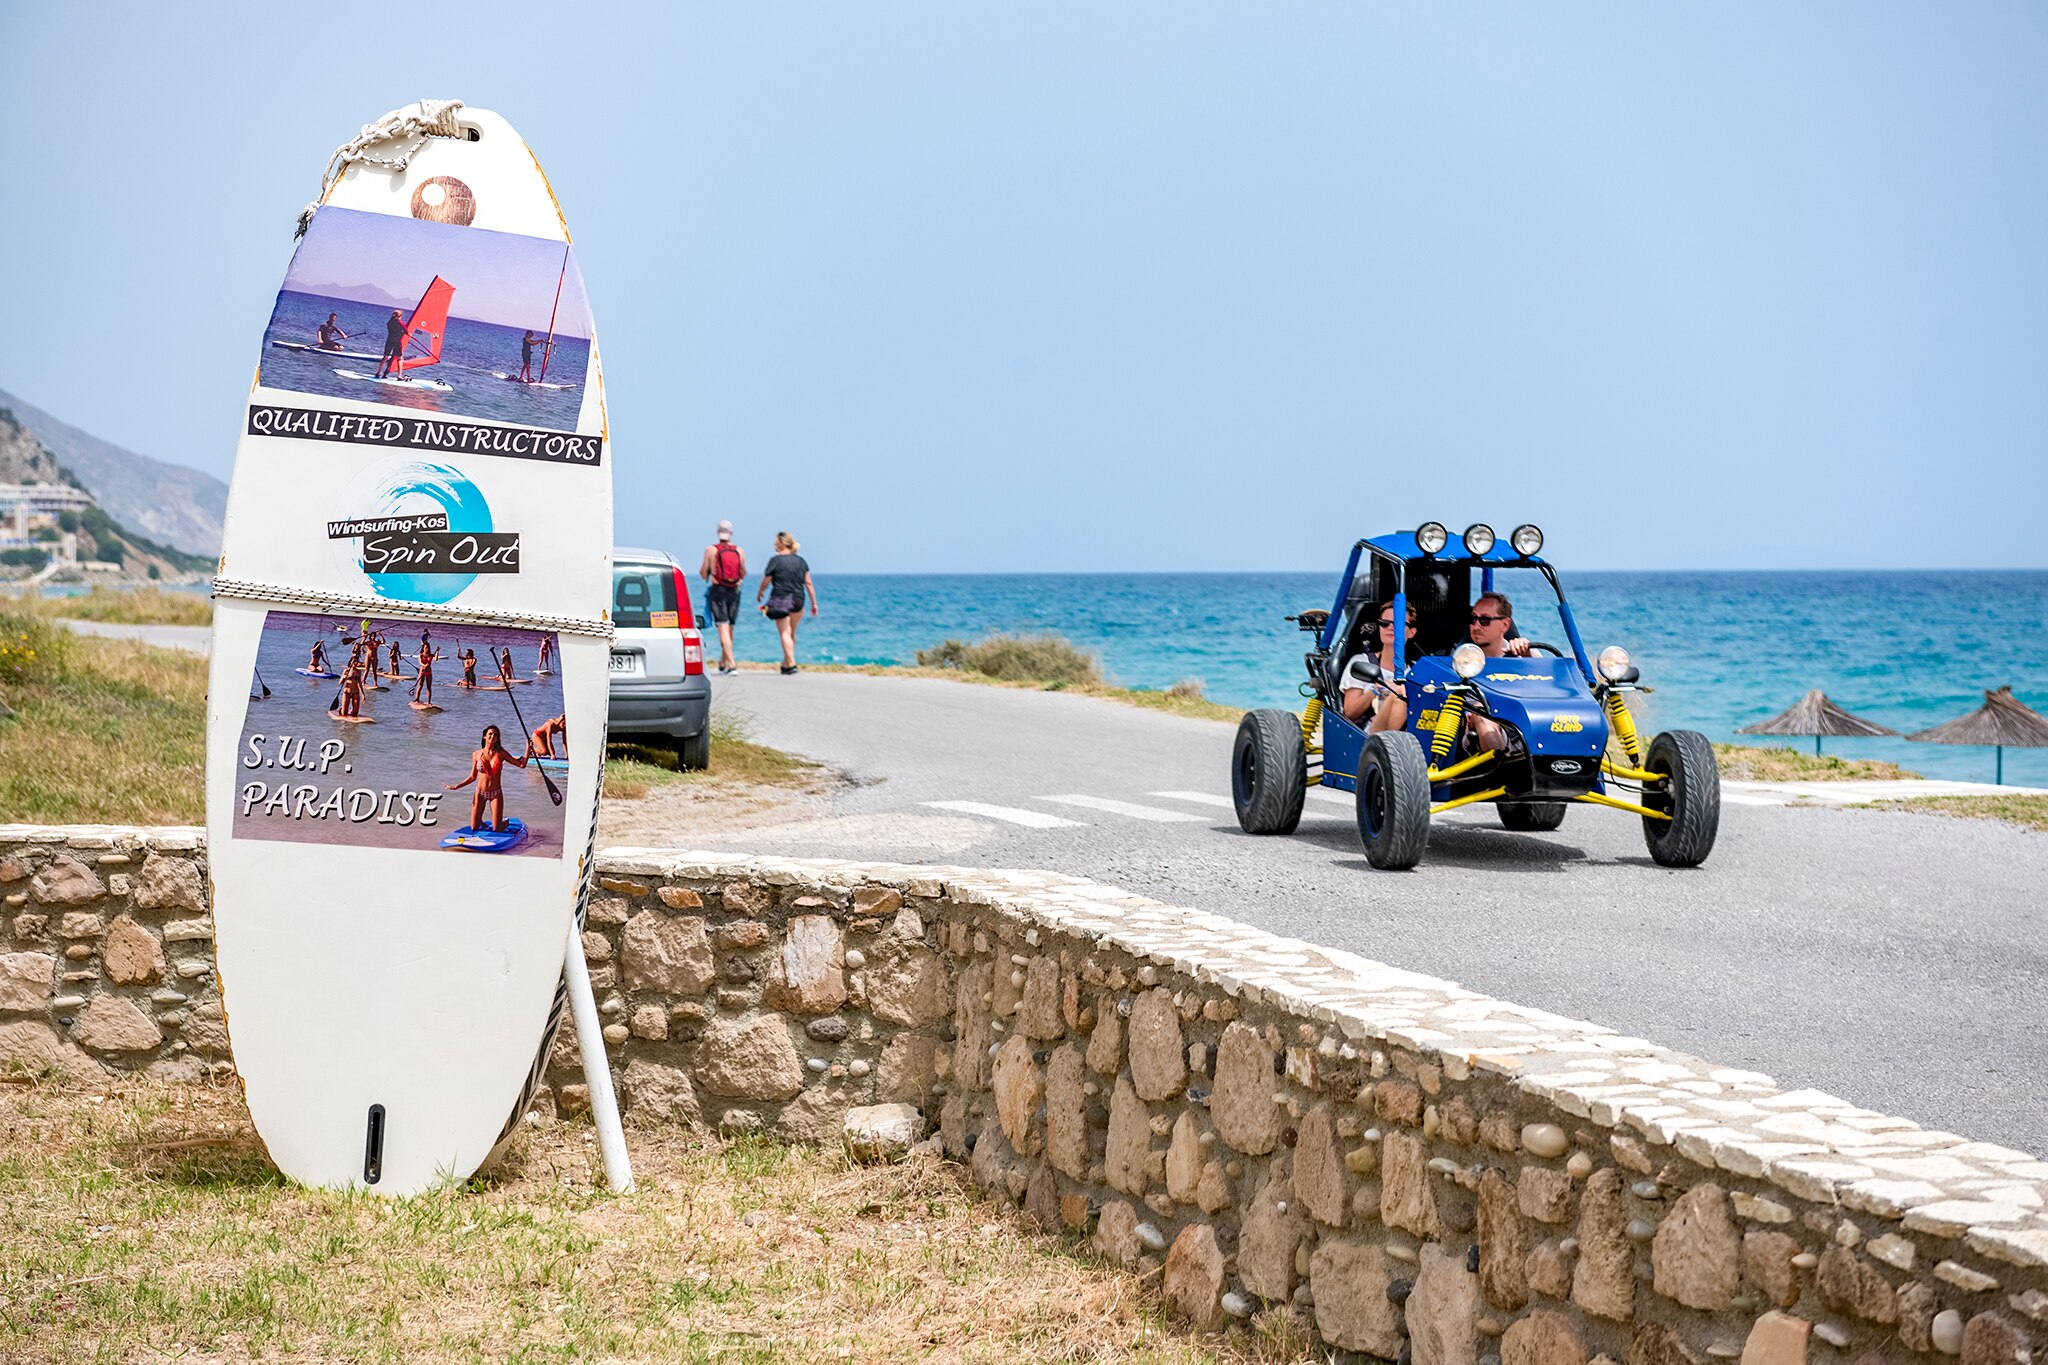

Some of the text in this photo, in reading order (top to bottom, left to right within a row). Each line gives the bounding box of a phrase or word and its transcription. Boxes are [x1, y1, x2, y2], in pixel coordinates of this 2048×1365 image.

[252, 408, 598, 461] QUALIFIED INSTRUCTORS
[328, 515, 446, 535] Windsurfing-Kos
[363, 536, 519, 574] Spin Out
[1551, 722, 1583, 732] ISLAND
[1553, 714, 1580, 724] MOTO
[243, 734, 353, 773] S.U.P.
[243, 781, 443, 826] PARADISE
